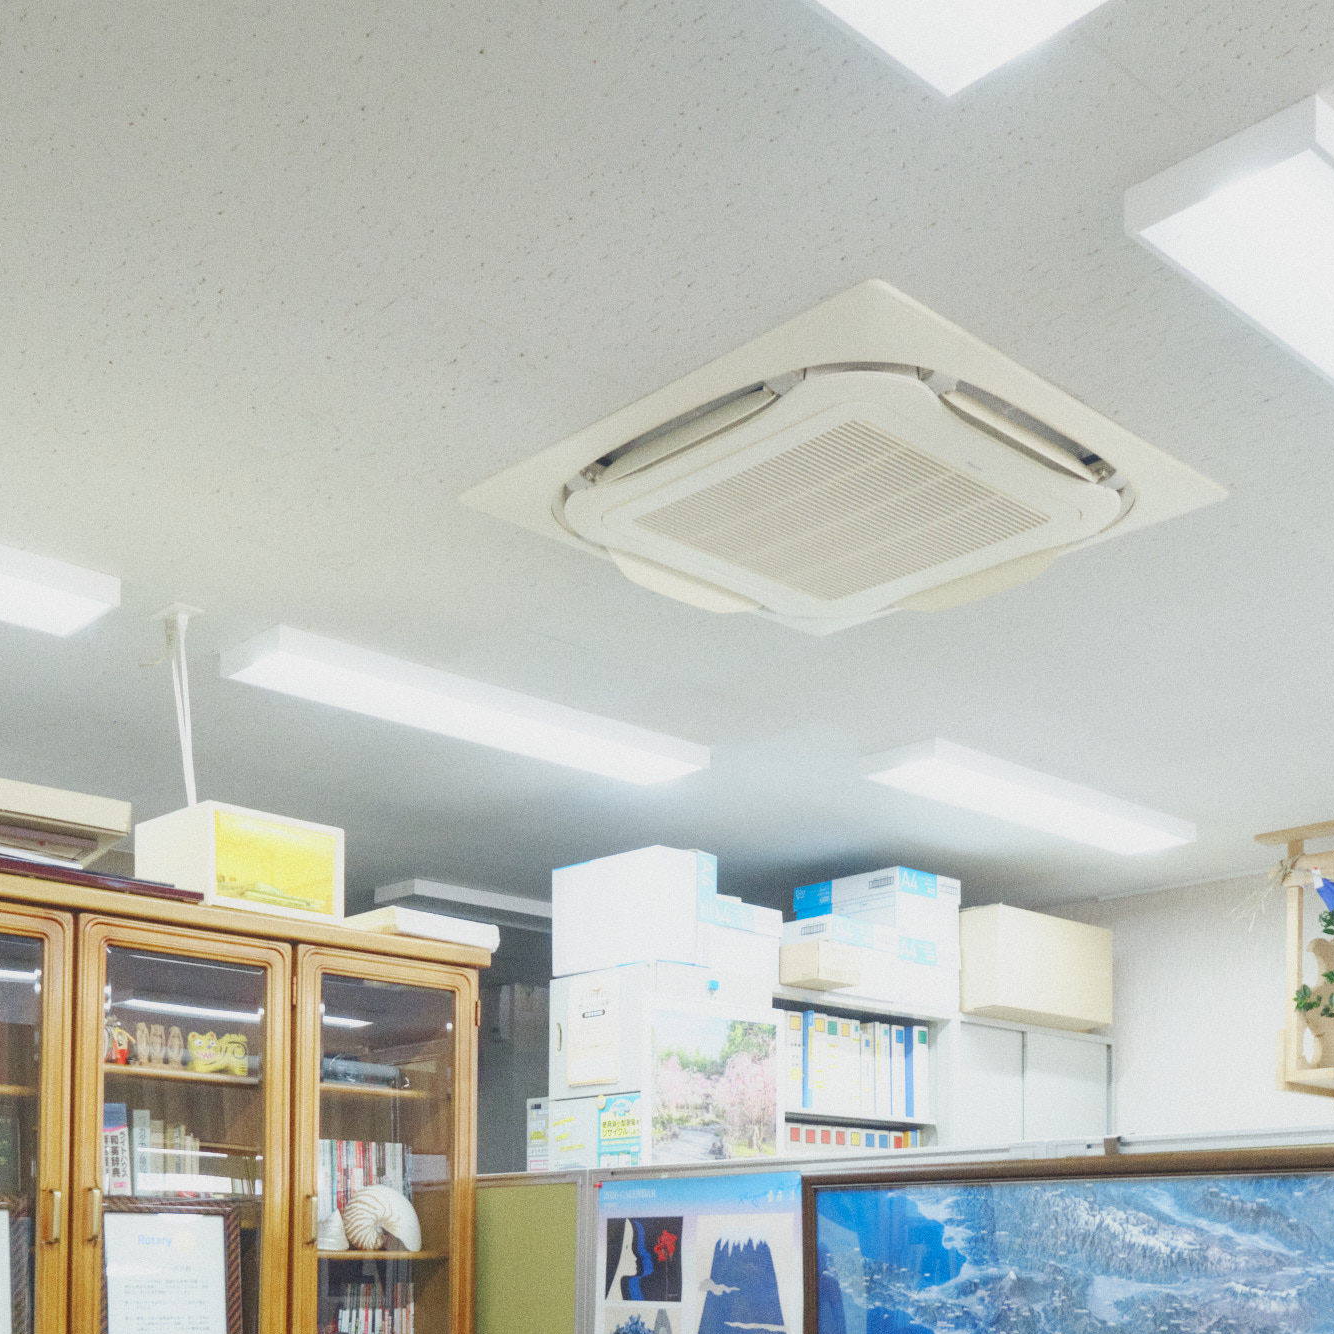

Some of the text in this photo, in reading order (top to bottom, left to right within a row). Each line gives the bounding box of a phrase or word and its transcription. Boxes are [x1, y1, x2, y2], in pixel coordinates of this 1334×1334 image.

[901, 870, 918, 890] A4
[620, 1188, 656, 1199] CALENDAR
[137, 1235, 172, 1247] Rotary
